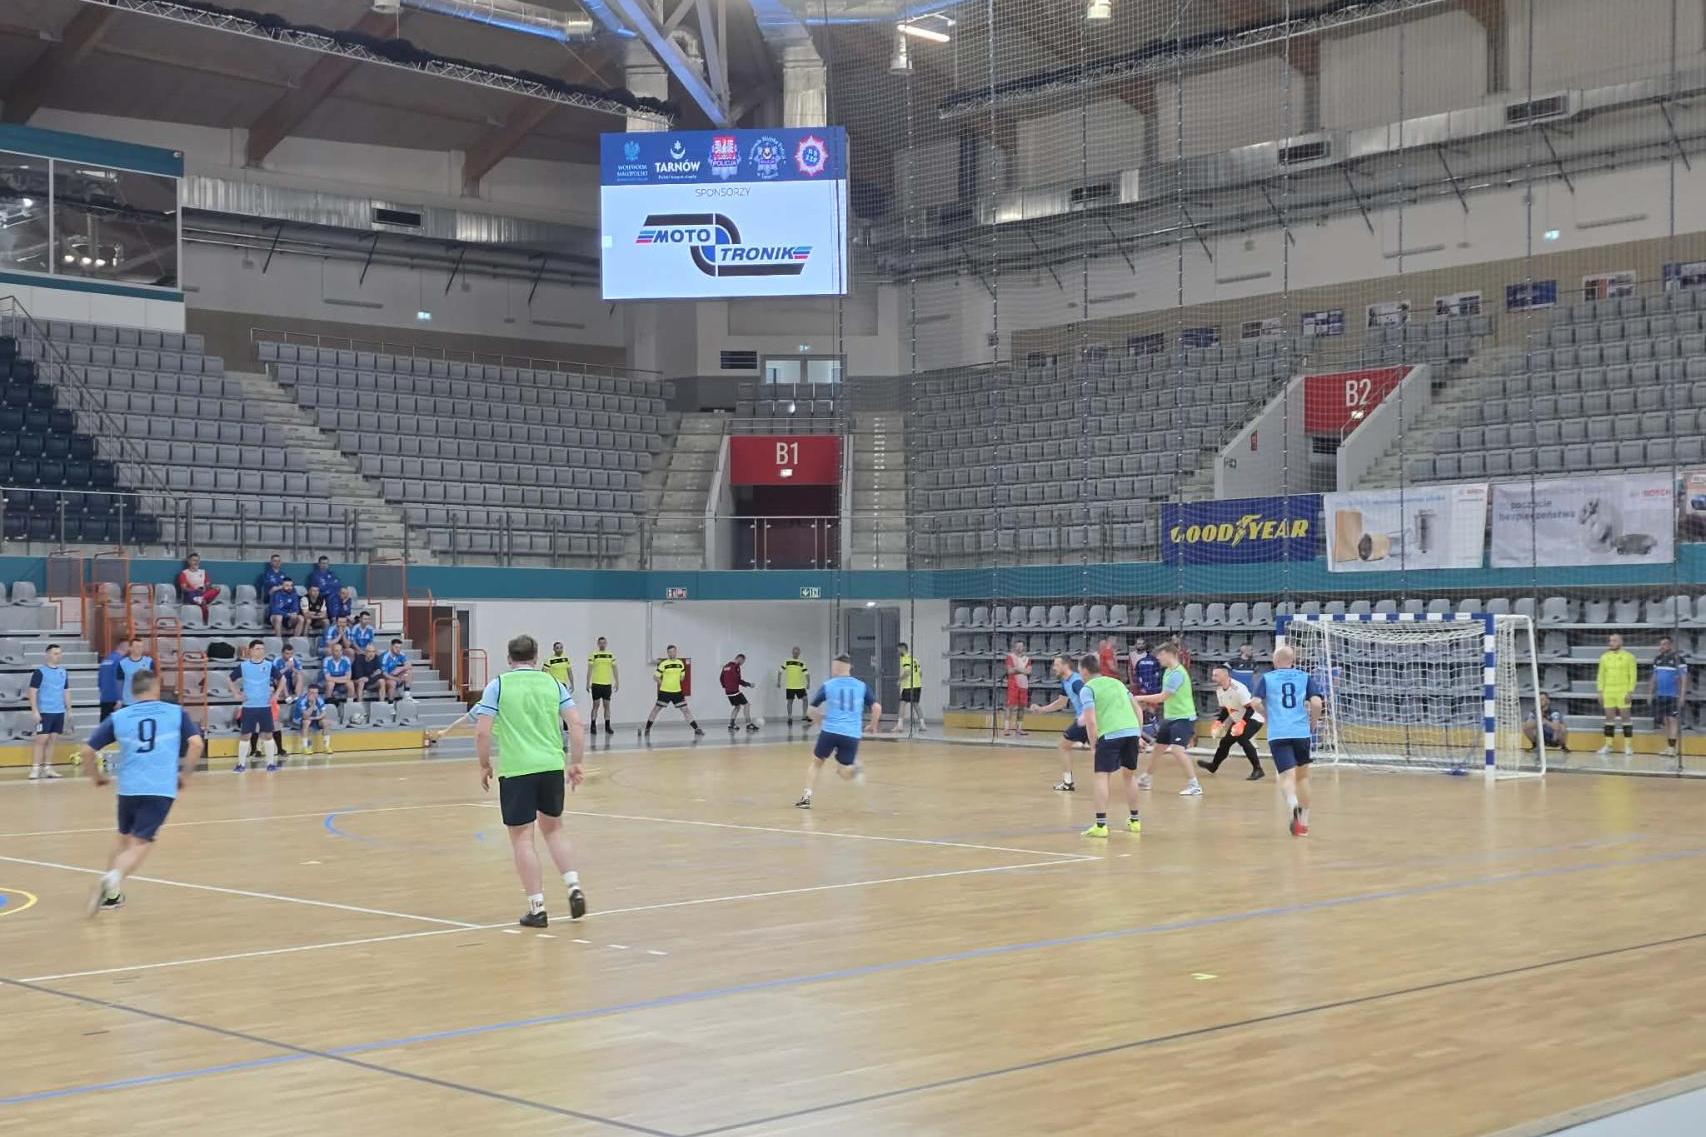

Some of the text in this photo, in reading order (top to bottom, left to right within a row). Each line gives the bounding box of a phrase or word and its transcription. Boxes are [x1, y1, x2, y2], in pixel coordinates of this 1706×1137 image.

[655, 159, 700, 173] TARNÓW
[695, 187, 751, 198] SPONSORZY
[653, 228, 711, 244] MOTO
[720, 246, 794, 261] TRONIK
[1345, 378, 1372, 406] B2
[776, 442, 799, 465] B1
[839, 688, 855, 712] 11
[1281, 682, 1297, 709] 8
[136, 718, 157, 753] 9
